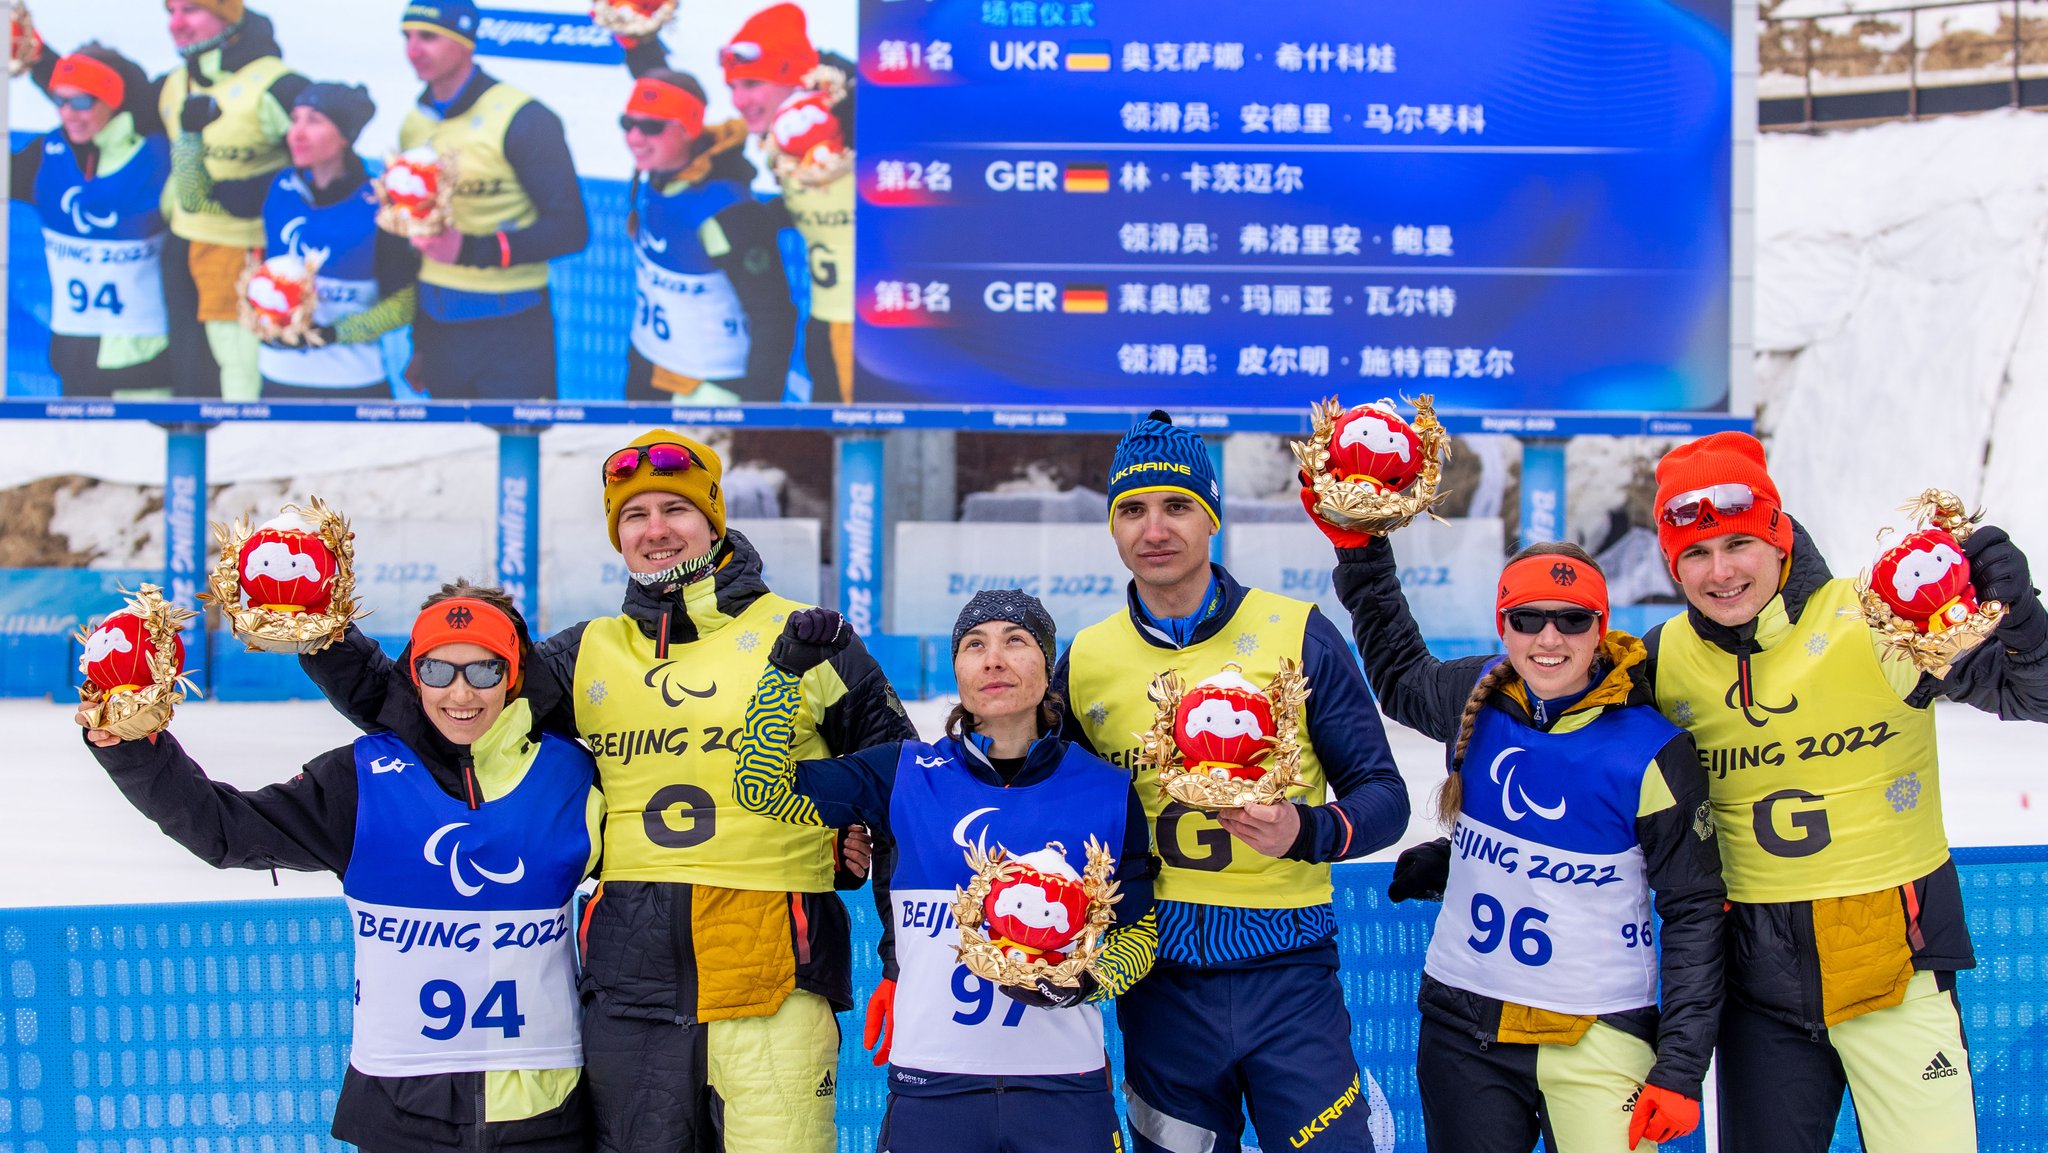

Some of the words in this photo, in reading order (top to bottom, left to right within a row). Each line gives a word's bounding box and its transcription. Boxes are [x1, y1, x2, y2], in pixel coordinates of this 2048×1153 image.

[982, 1, 1096, 27] 场馆仪式
[878, 40, 953, 71] 第1名
[990, 41, 1060, 71] UKR
[875, 160, 953, 192] 第2名
[985, 162, 1057, 192] GER
[809, 243, 838, 289] G
[68, 279, 124, 315] 94
[874, 281, 952, 312] 第3名
[983, 282, 1057, 312] GER
[1112, 462, 1191, 485] UKRAINE
[844, 482, 874, 582] BEIJING
[1697, 521, 1720, 531] adidas
[1049, 575, 1121, 596] 2022
[1401, 568, 1455, 586] 022
[588, 727, 688, 765] BEIJING
[1698, 741, 1785, 779] EIJING
[1796, 722, 1901, 761] 2022
[642, 784, 716, 848] G
[1752, 789, 1832, 858] G
[1156, 801, 1232, 872] G
[1454, 821, 1519, 873] EIJING
[1527, 855, 1624, 887] 2022
[357, 911, 481, 953] BEIJING
[493, 914, 569, 950] 2022
[1467, 893, 1553, 966] 96
[1621, 921, 1653, 948] 96
[419, 979, 526, 1041] 94
[1922, 1067, 1958, 1081] adidas
